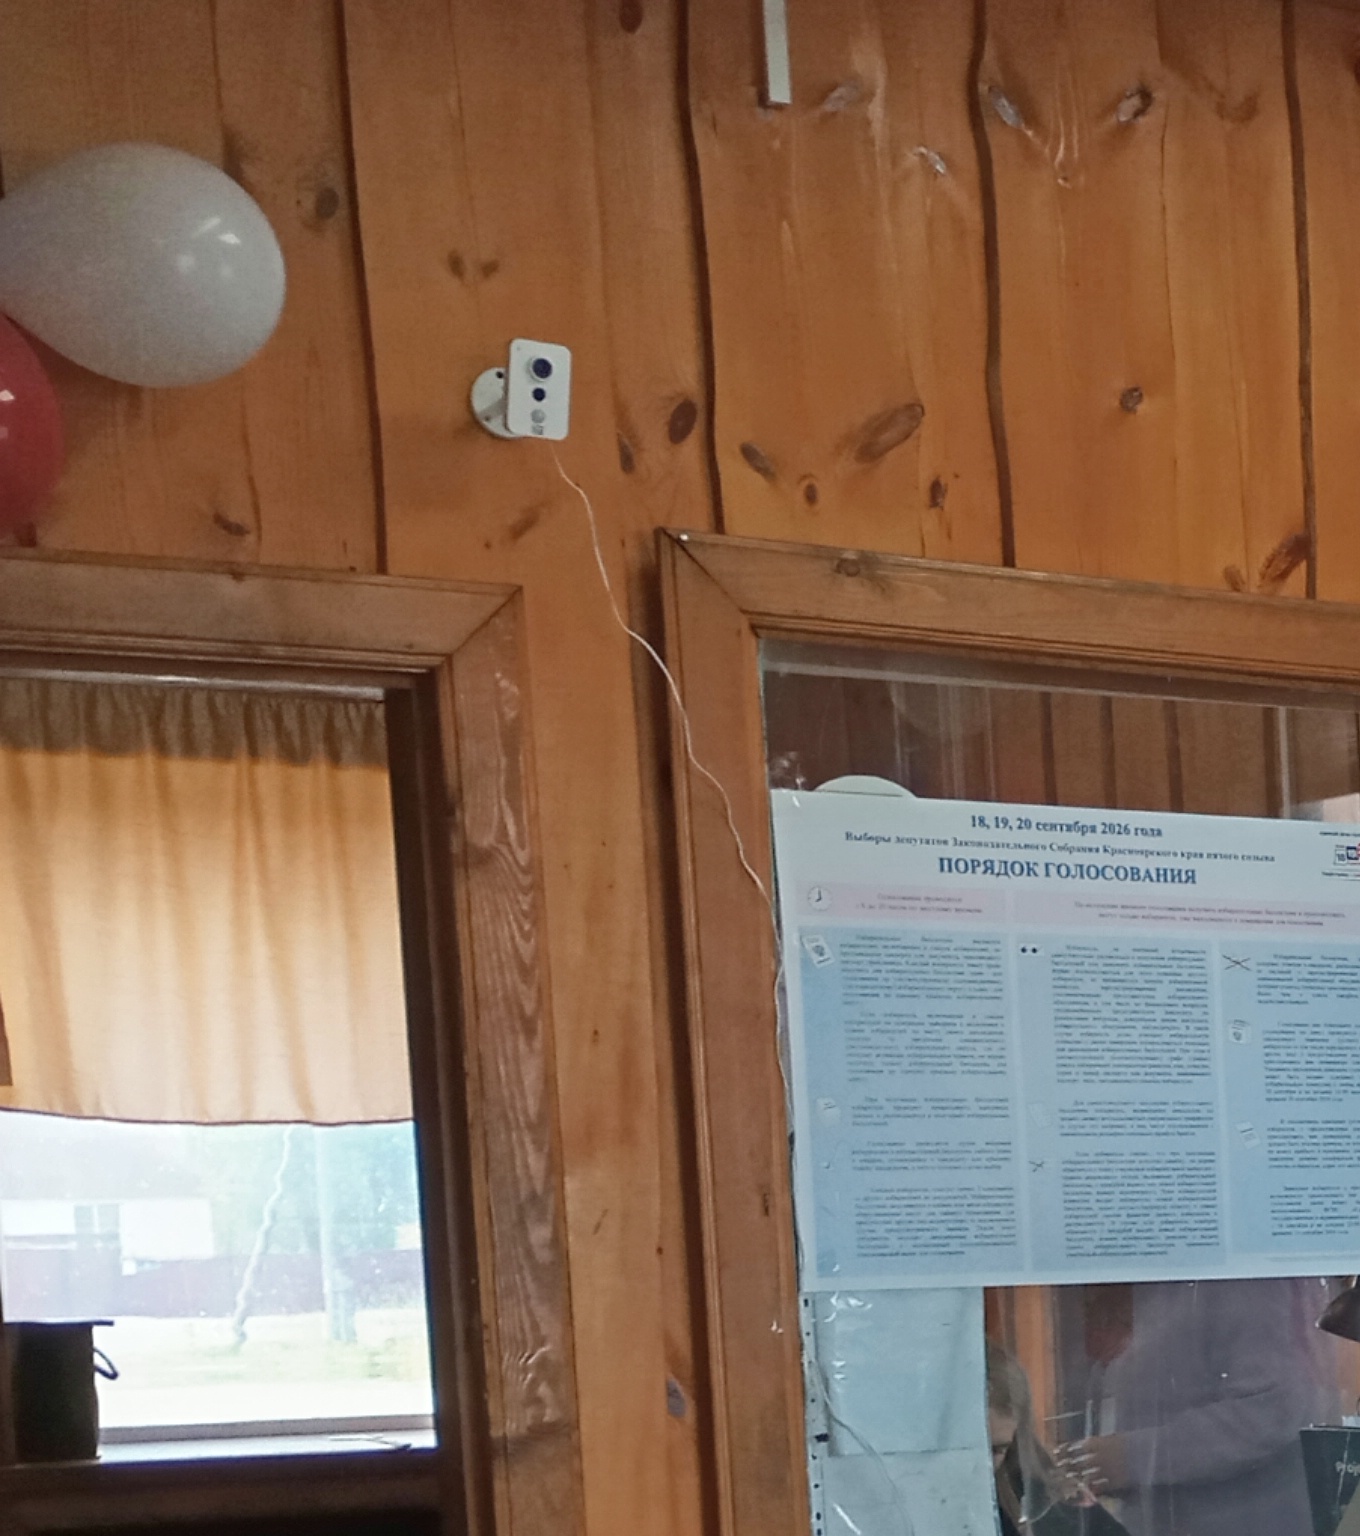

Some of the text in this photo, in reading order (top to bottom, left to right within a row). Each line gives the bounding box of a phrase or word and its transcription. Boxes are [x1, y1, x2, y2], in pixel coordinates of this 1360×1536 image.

[970, 815, 1163, 837] 18, 19, 20 сентября 2026 года
[845, 831, 892, 845] Выборы
[1048, 842, 1100, 854] Собрания
[938, 857, 1197, 884] ПОРЯДОК ГОЛОСОВАНИЯ
